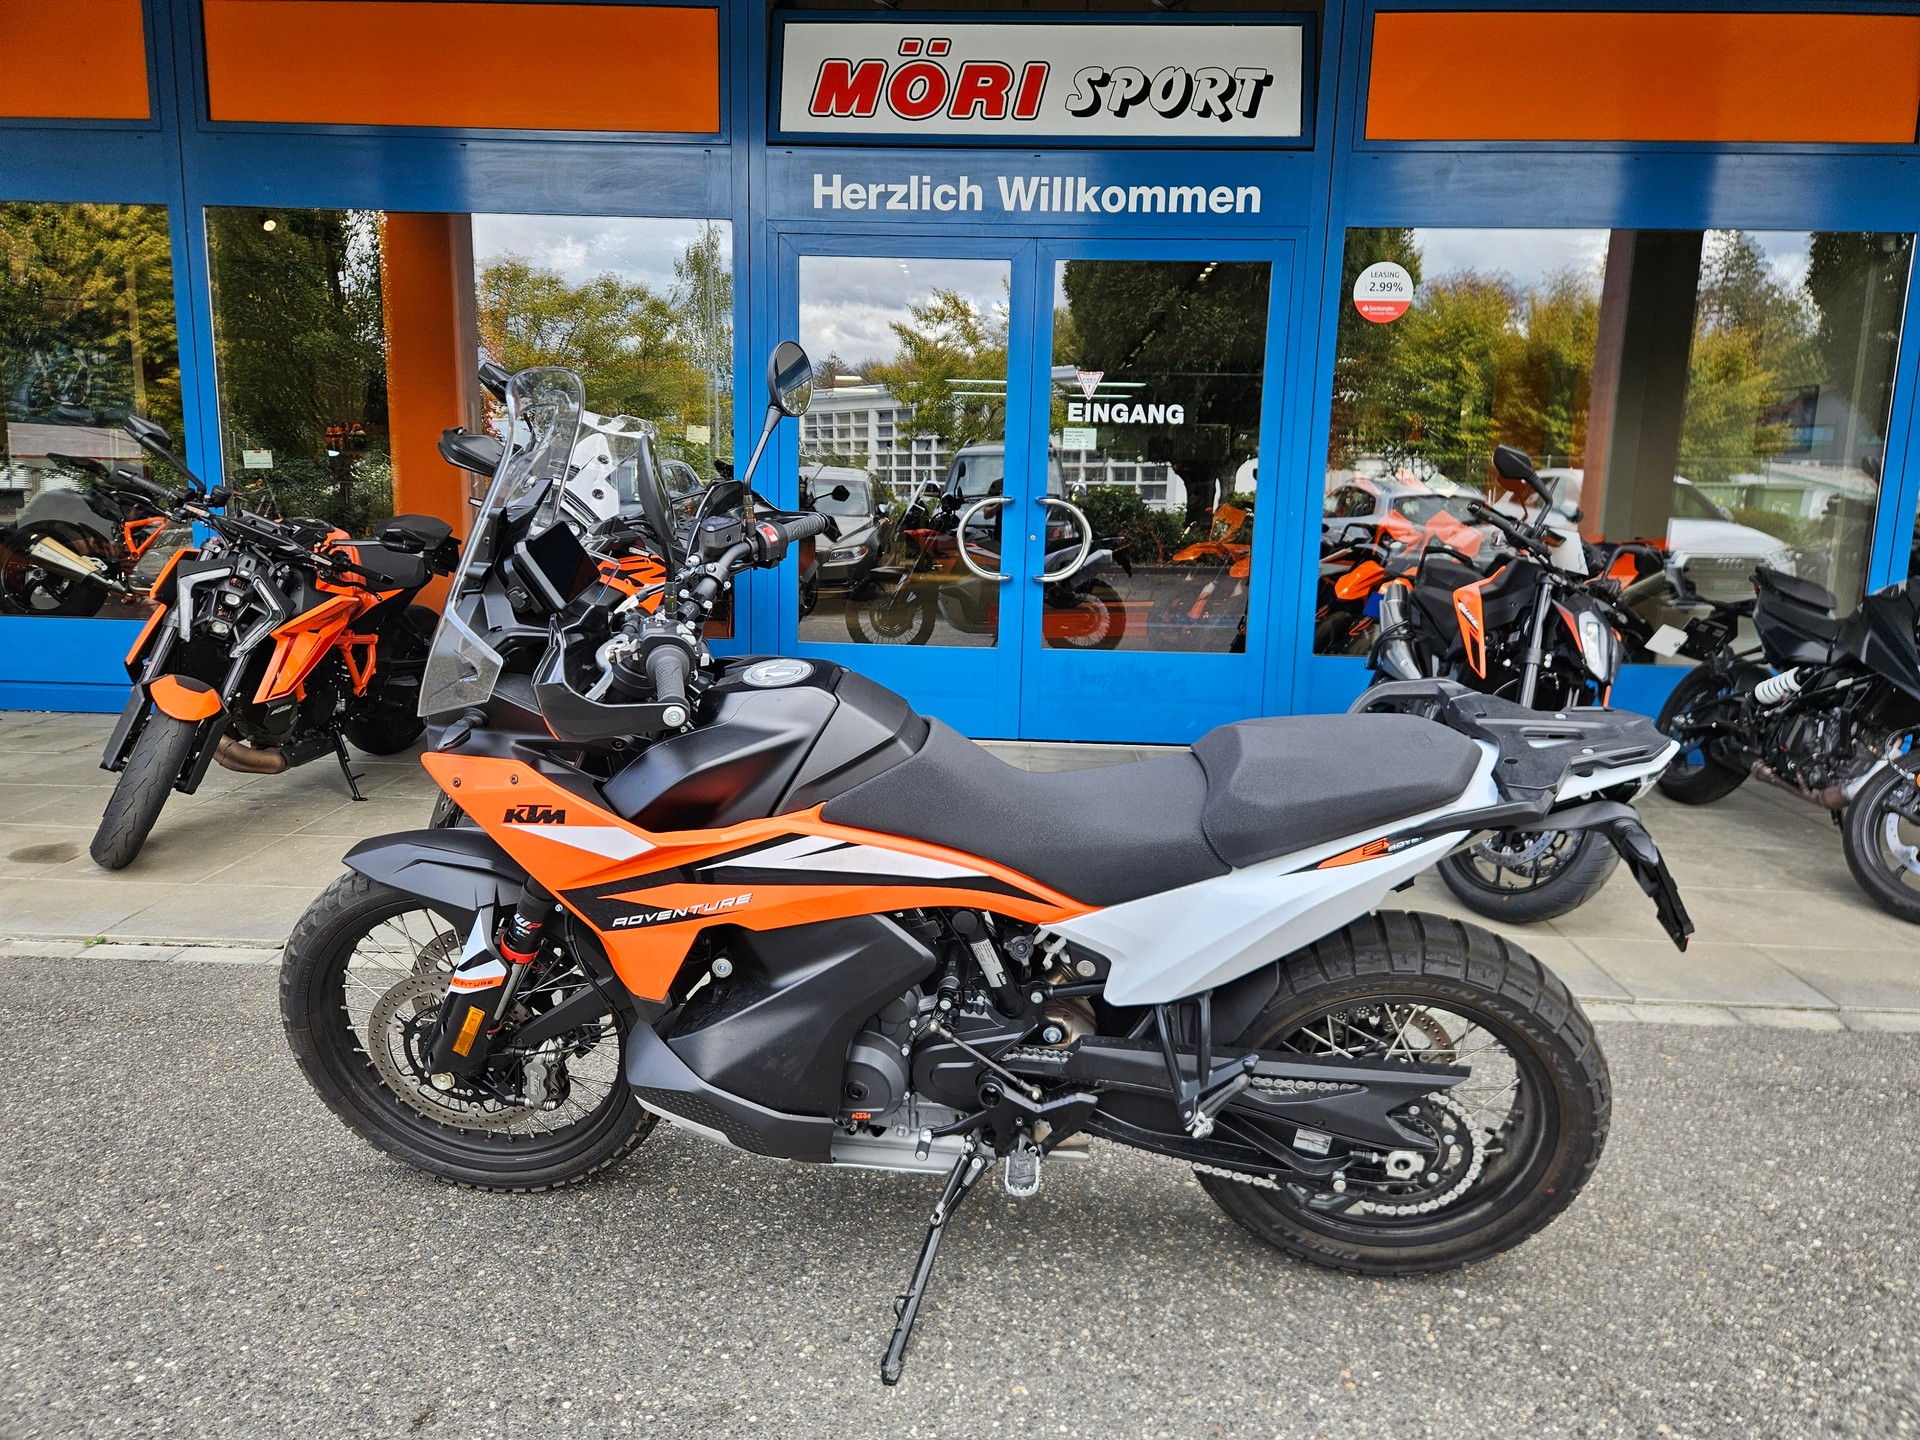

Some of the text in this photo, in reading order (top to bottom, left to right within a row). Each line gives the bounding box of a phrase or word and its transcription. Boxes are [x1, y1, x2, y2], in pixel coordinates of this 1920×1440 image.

[809, 38, 1273, 123] MÖRI SPORT
[813, 174, 1261, 213] Herzlich Willkommen
[1369, 282, 1403, 292] 2.99%
[1068, 402, 1184, 424] EINGANG
[503, 805, 566, 824] KTM
[612, 893, 753, 927] ADVENTURE
